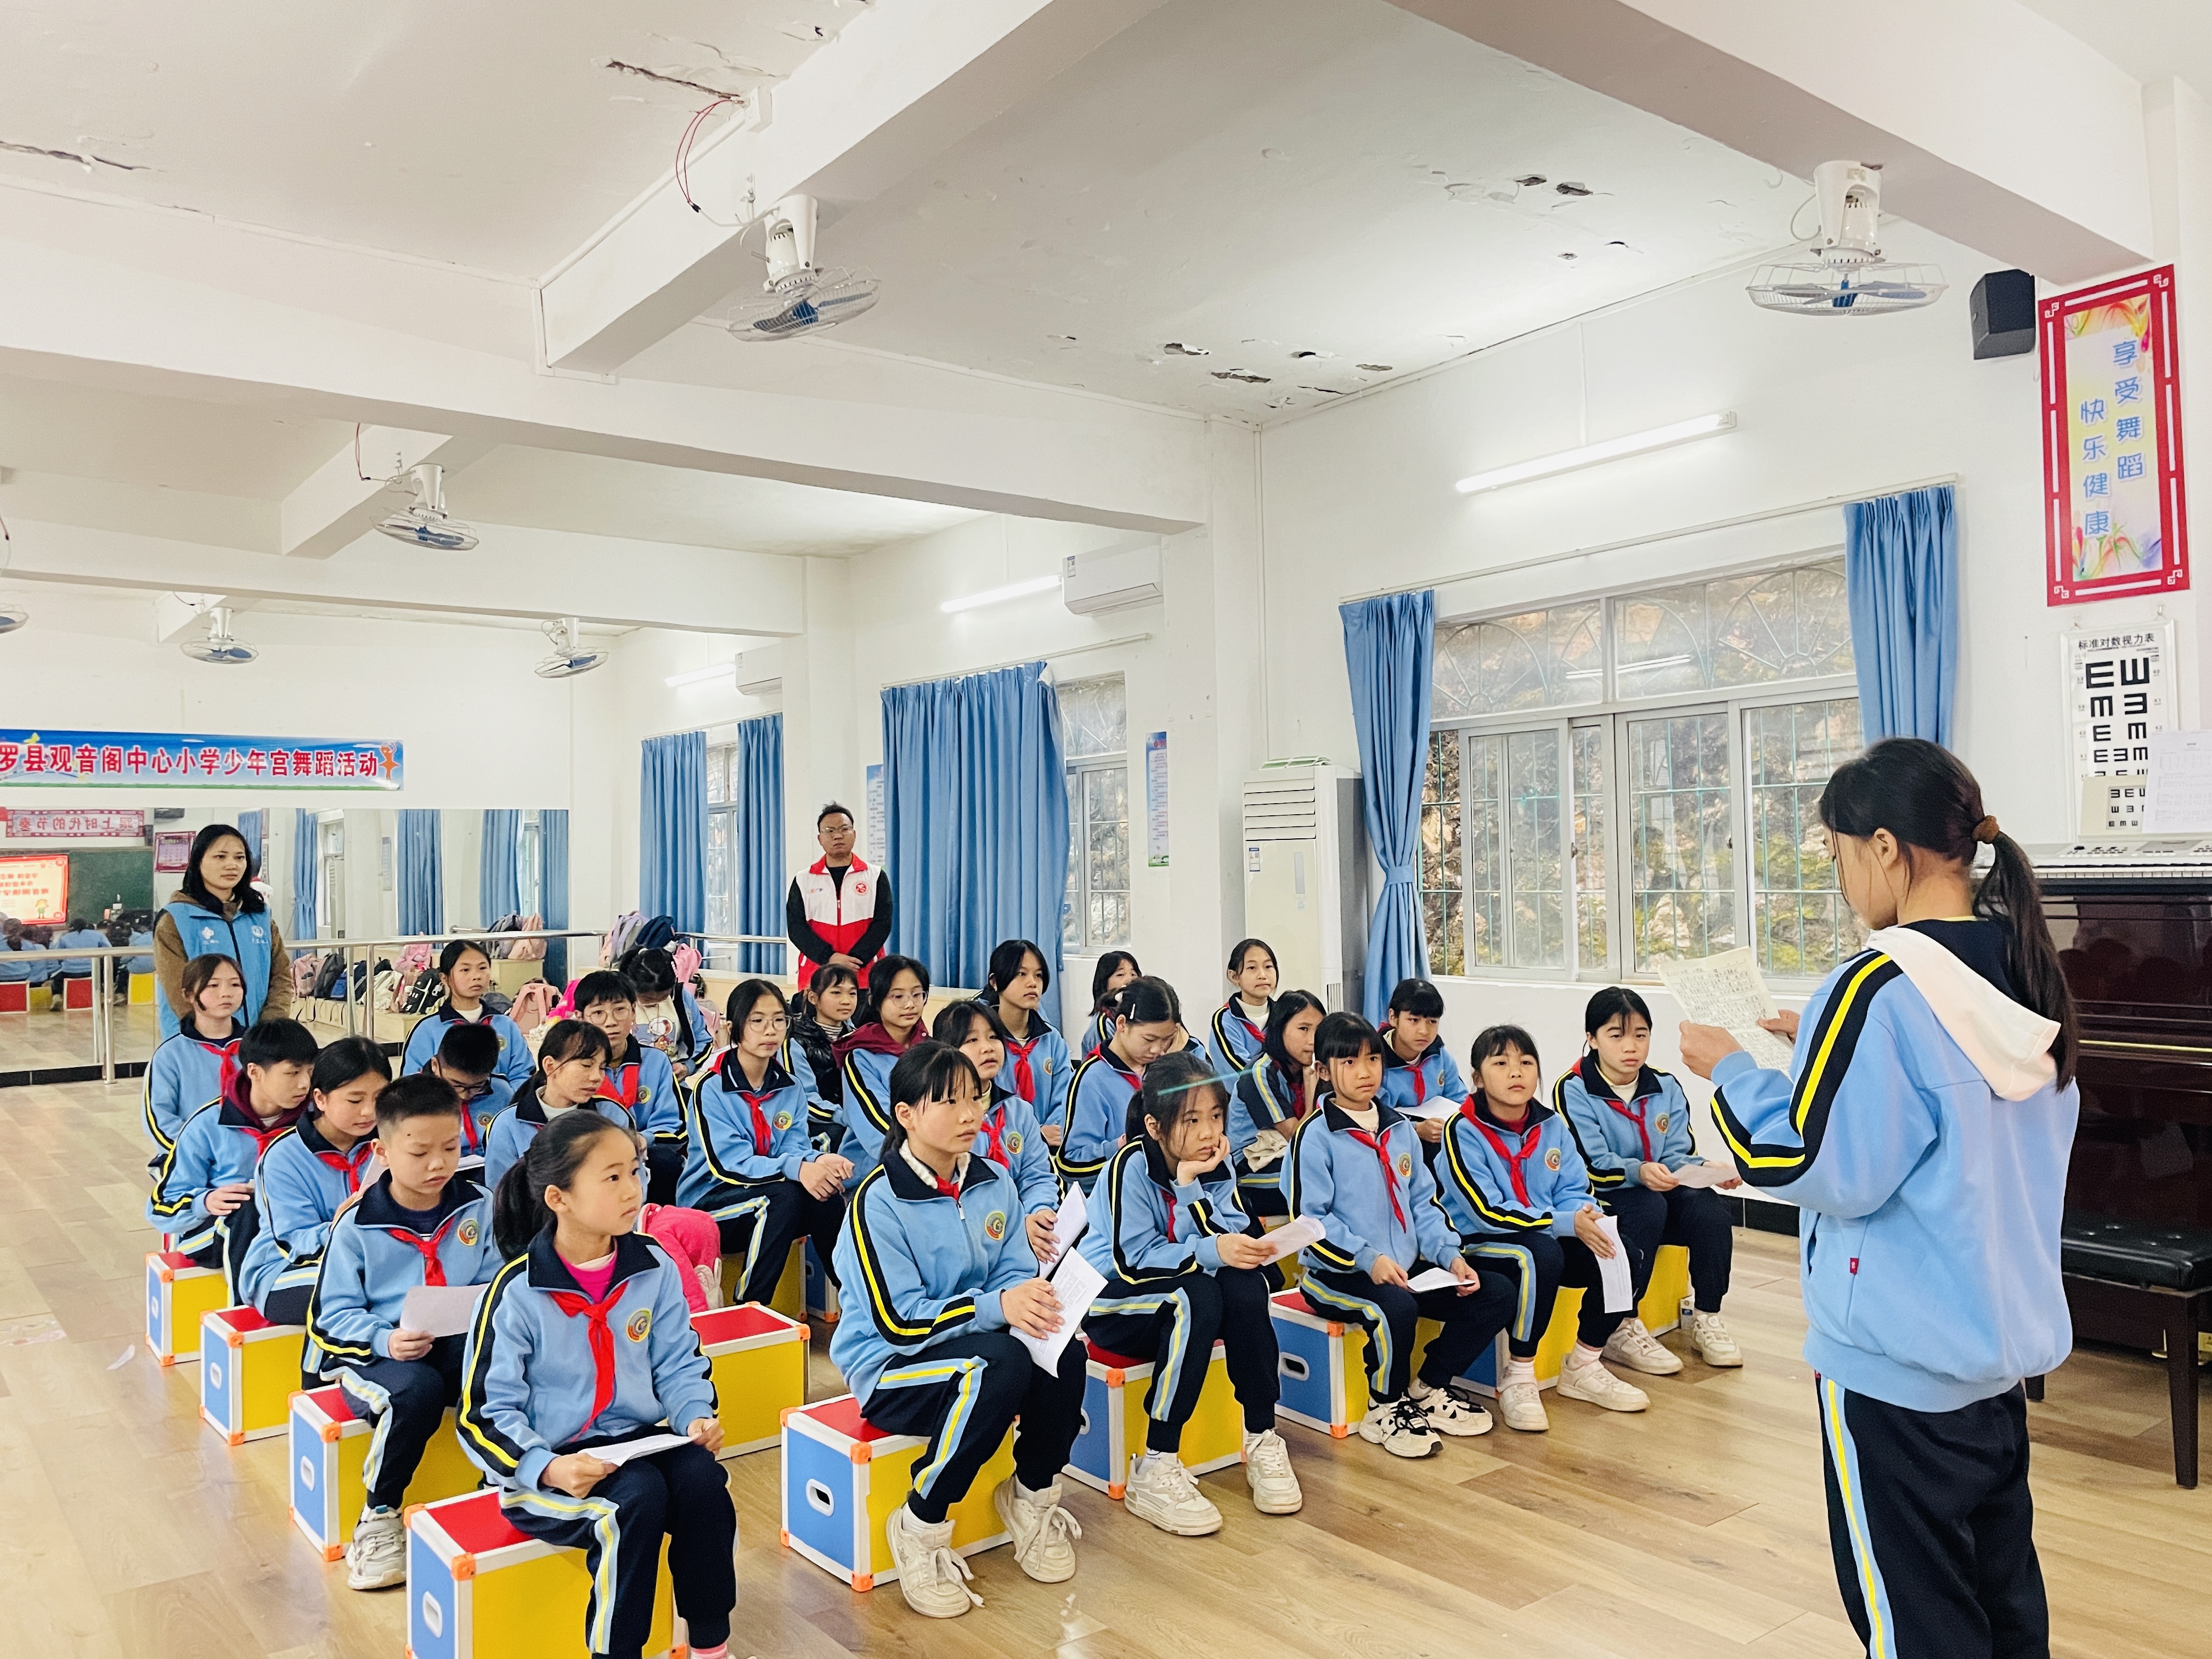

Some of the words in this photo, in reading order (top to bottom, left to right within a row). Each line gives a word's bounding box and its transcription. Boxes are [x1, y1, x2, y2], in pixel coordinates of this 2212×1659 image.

[2113, 340, 2143, 479] 享受舞蹈
[2080, 398, 2110, 536] 快乐健康
[2078, 633, 2155, 650] 标准对数视力表
[0, 744, 377, 777] 罗县观音阁中心小学少年宫舞蹈活动
